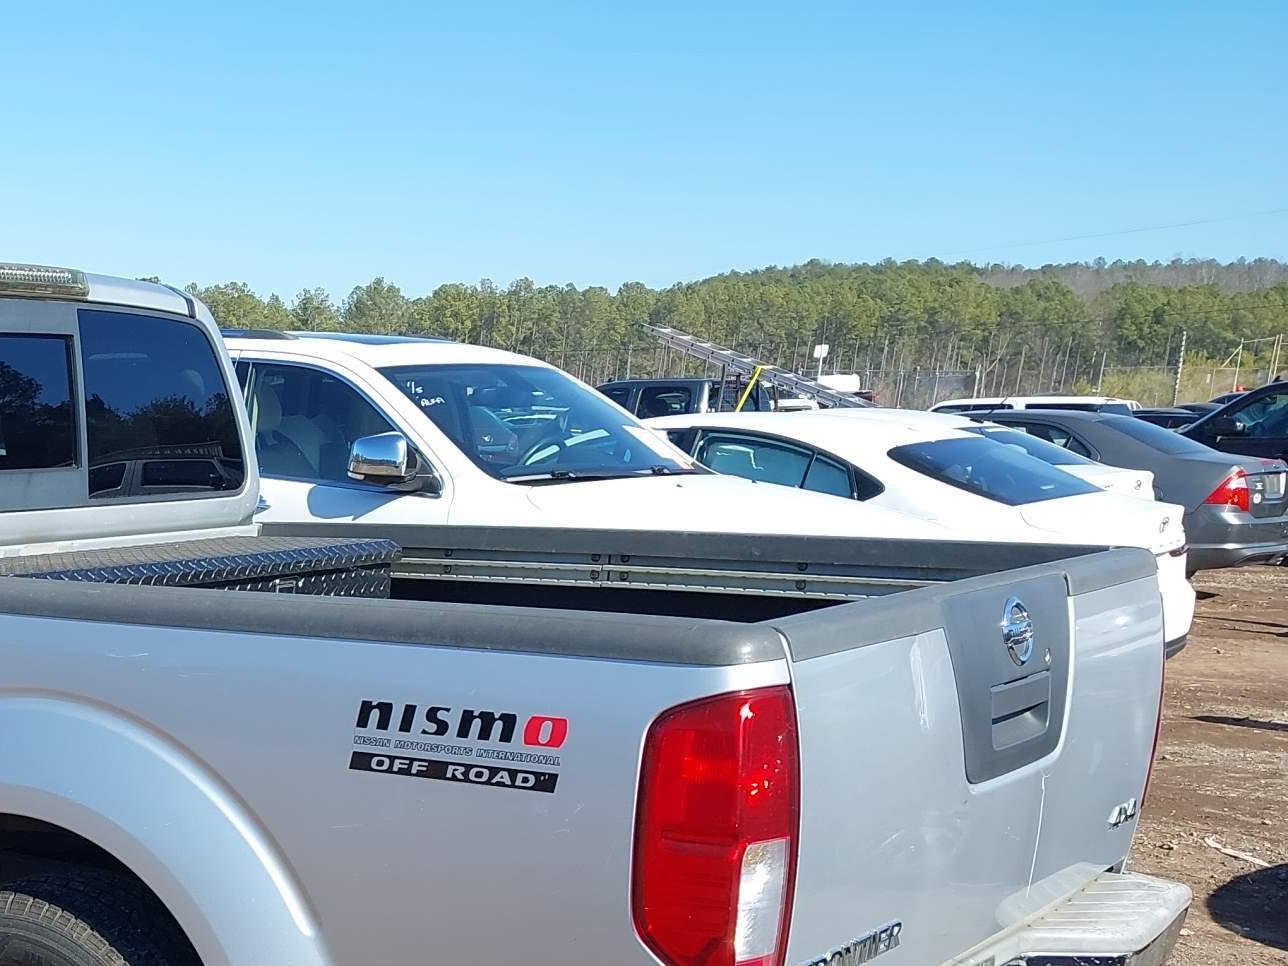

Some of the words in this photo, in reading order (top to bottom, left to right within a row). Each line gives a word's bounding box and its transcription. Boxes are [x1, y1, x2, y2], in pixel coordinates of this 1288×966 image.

[353, 735, 392, 748] NISSAN
[394, 740, 473, 756] MOTORSPORTS
[476, 748, 561, 766] INTERNATIONAL
[370, 756, 430, 774] OFF
